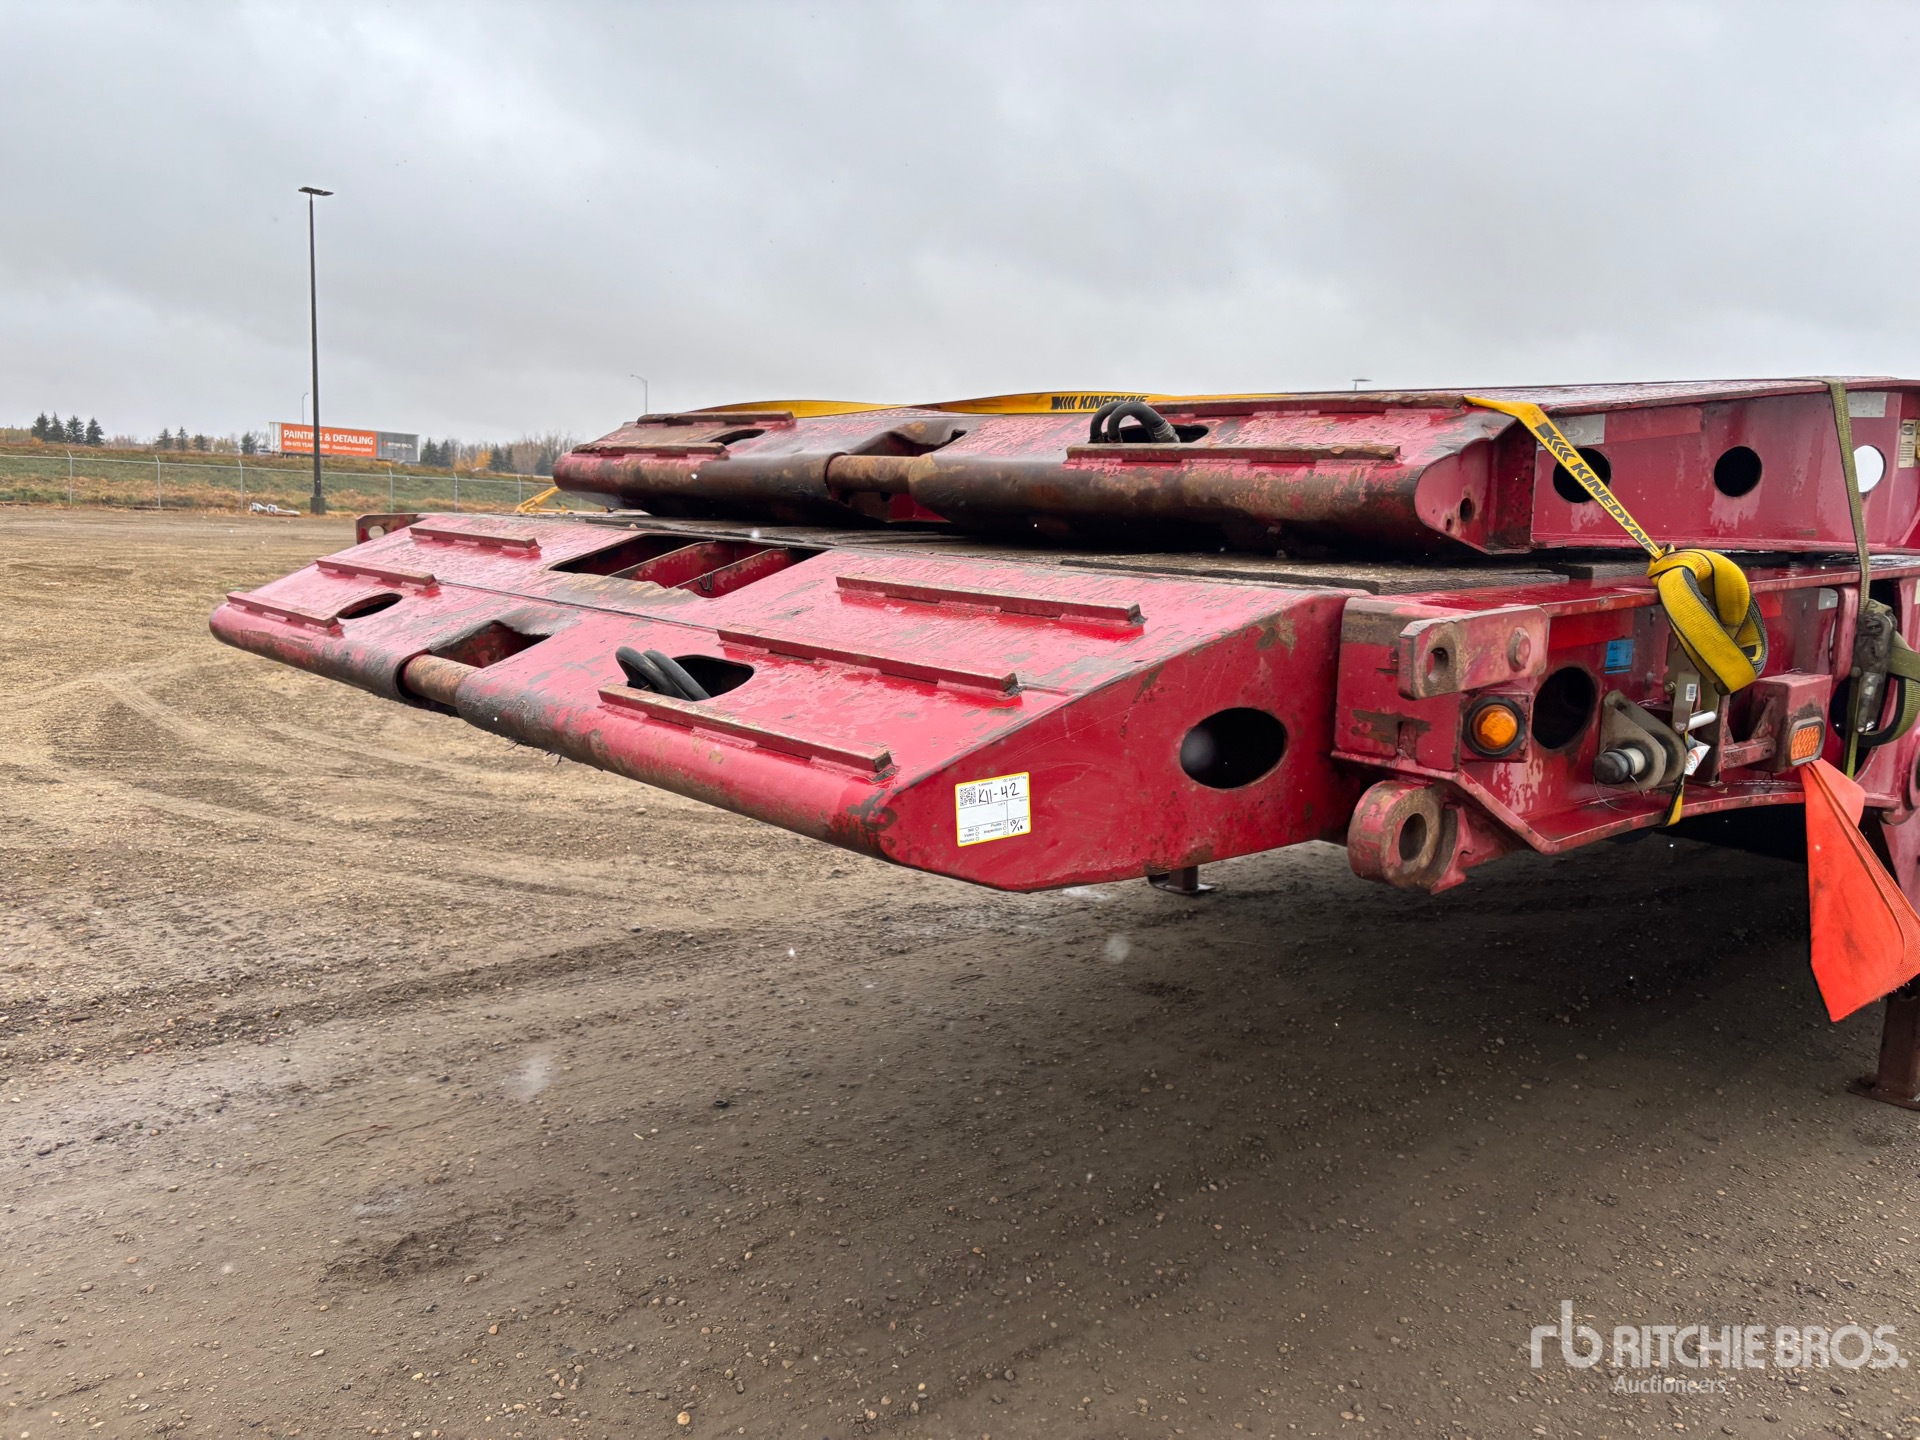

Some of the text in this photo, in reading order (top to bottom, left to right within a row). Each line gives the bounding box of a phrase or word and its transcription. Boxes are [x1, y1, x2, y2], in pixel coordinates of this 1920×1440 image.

[324, 432, 331, 442] &
[333, 433, 374, 445] DETAILING
[1570, 462, 1658, 556] KINEDYNE
